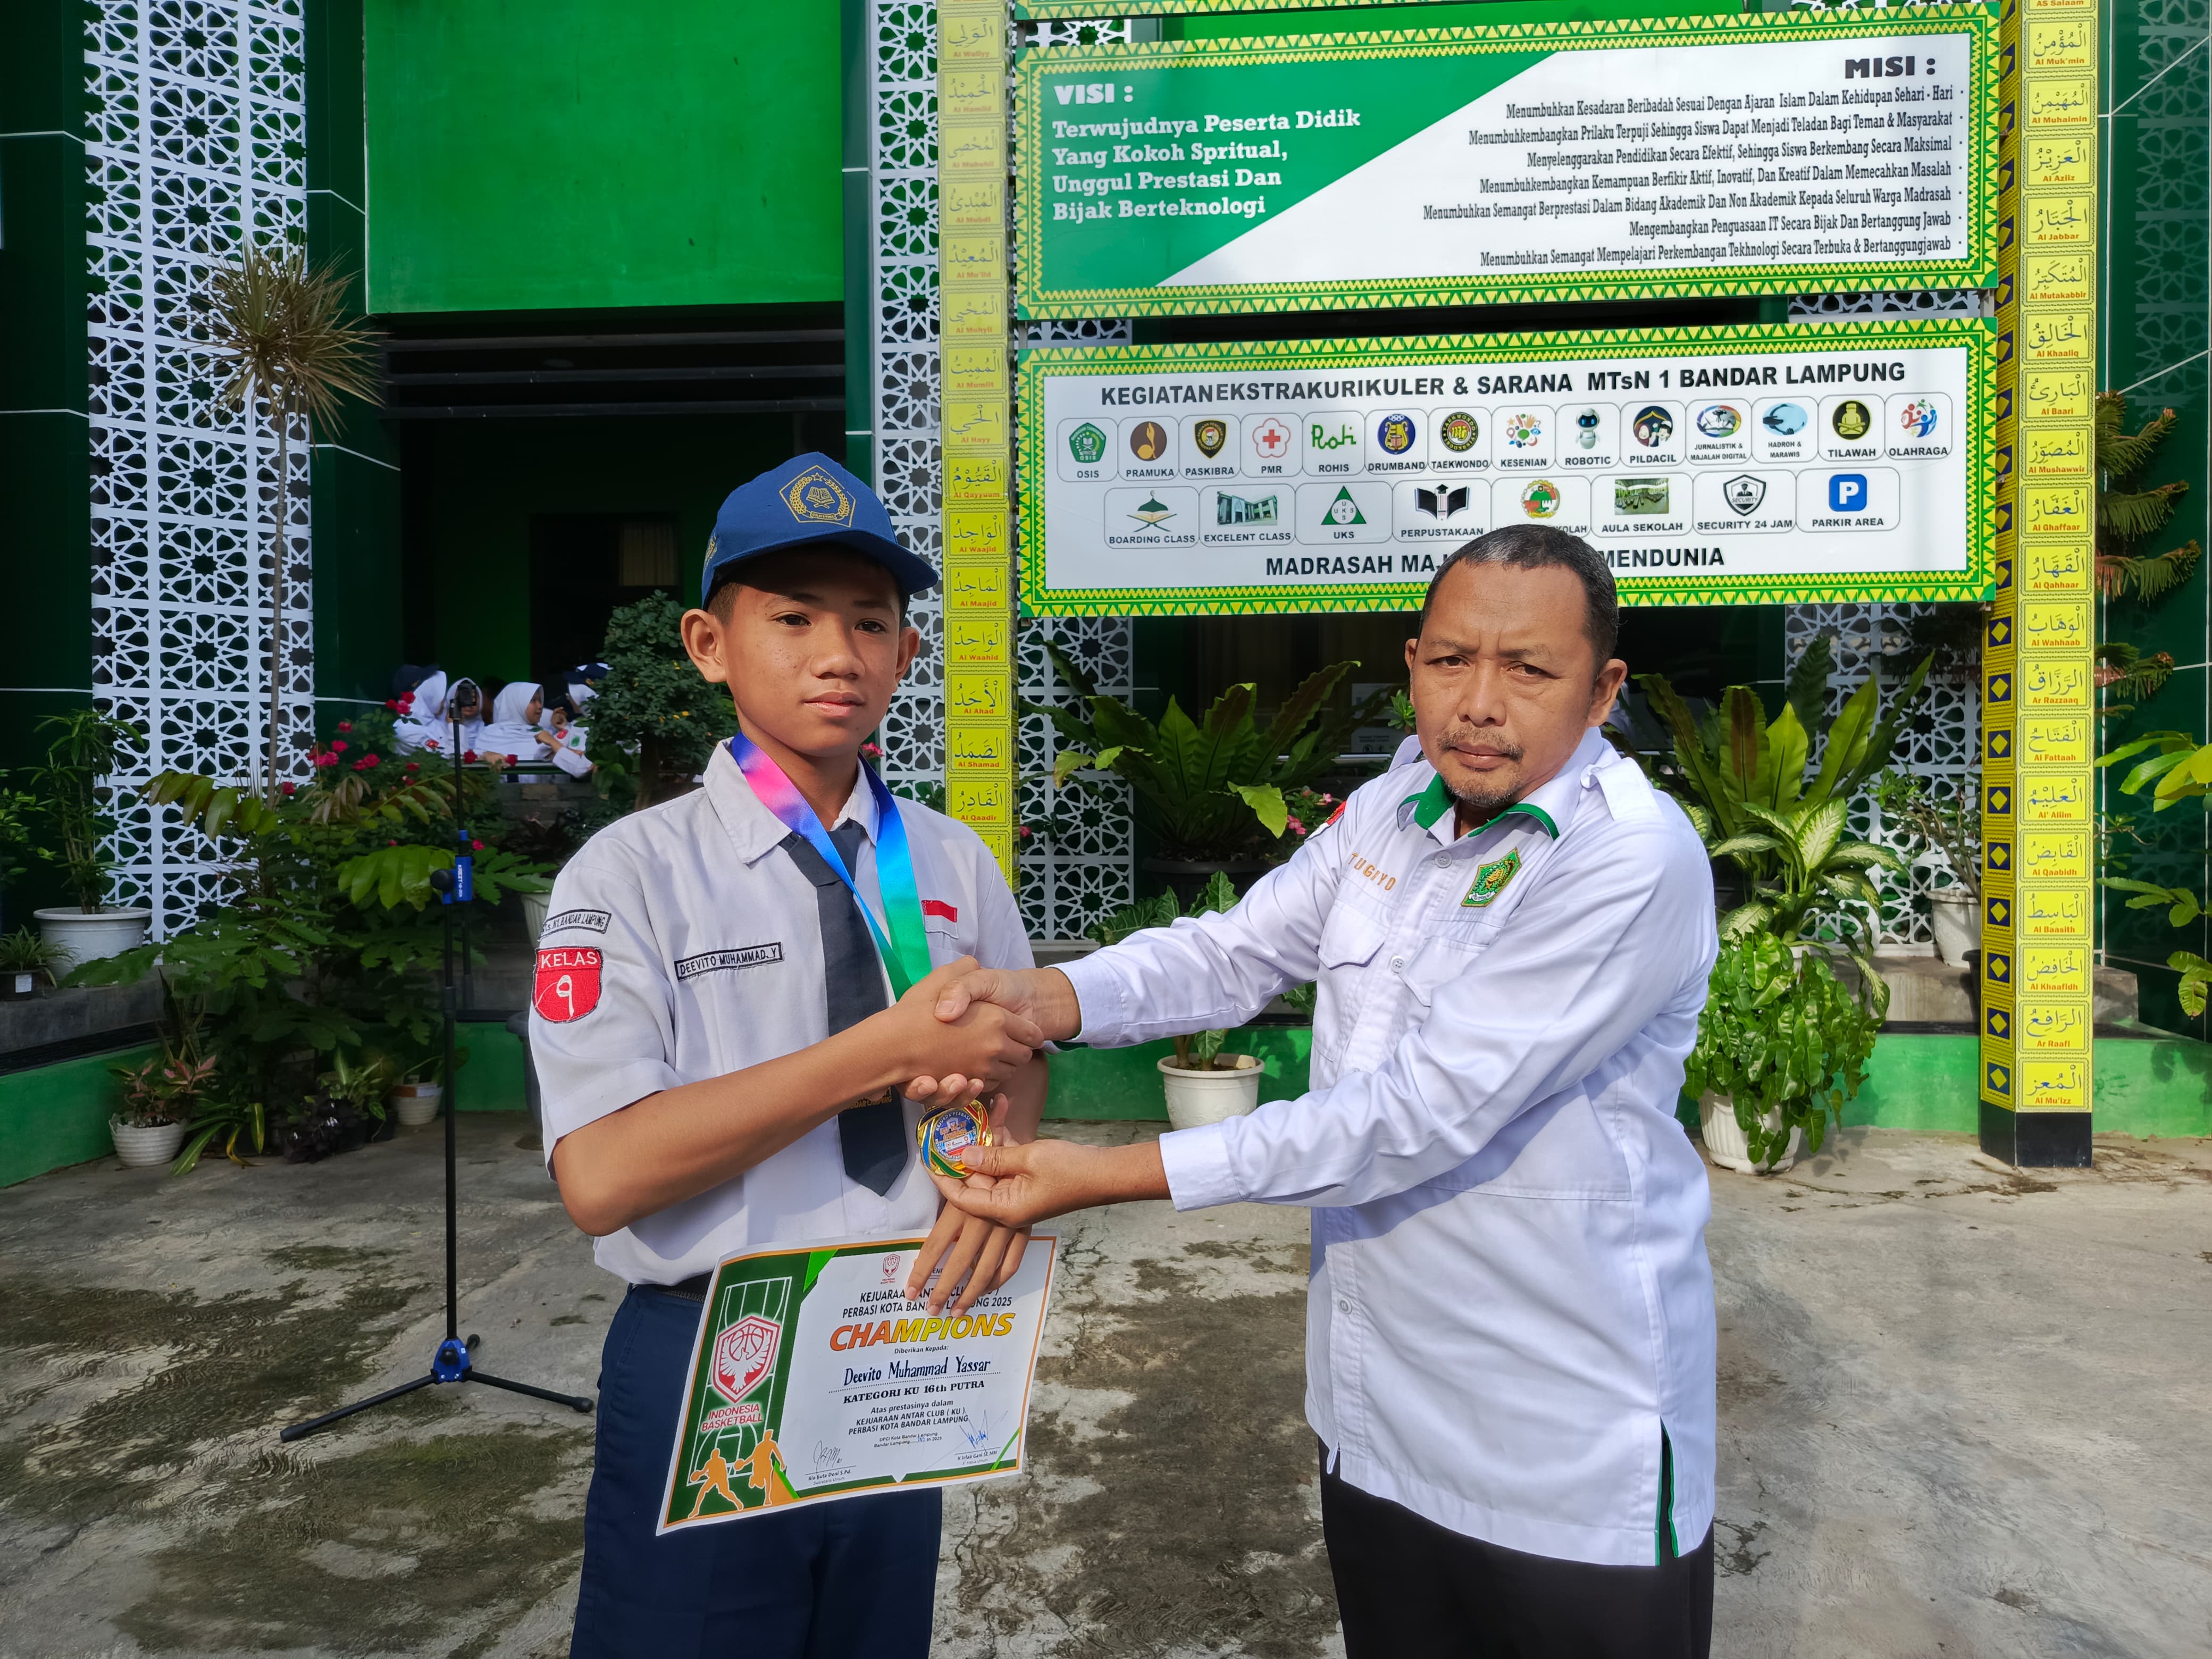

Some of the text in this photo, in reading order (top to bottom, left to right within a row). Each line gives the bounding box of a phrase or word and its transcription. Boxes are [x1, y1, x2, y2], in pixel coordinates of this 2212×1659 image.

[1052, 108, 1361, 140] Terwujudnya Peserta Didik
[1052, 139, 1287, 169] Yang Kokoh Spritual,
[1527, 135, 1952, 171] Menyelenggarakan Pendidikan Secara Efektif, Sehingga Siswa Berkembang Secara Maksimal
[1052, 168, 1282, 197] Unggul Prestasi Dan
[1480, 160, 1951, 195] Menumbuhkembangkan Kemampuan Berfikir Aktif, Inovatif, Dan Kreatif Dalam Memecahkan Masalah
[1053, 195, 1266, 224] Bijak Berteknologi
[1423, 185, 1951, 221] Menumbuhkan Semangat Berprestasi Dalam Bidang Akademik Dan Non Akademik Kepada Seluruh Warga Madrasah
[1453, 376, 1469, 395] &
[1477, 373, 1573, 395] SARANA
[1588, 370, 1649, 391] MTsN
[1659, 370, 1669, 389] 1
[1680, 366, 1778, 388] BANDAR
[1786, 362, 1905, 385] LAMPUNG
[1828, 448, 1876, 458] TILAWAH
[1889, 446, 1948, 456] OLAHRAGA
[1368, 462, 1425, 471] DRUMBAND
[1432, 459, 1488, 469] TAEKWONDO
[1501, 458, 1547, 467] KESENIAN
[1565, 455, 1611, 466] ROBOTIC
[1629, 454, 1677, 464] PILDACIL
[1126, 468, 1174, 477] PRAMUKA
[1186, 467, 1234, 476] PASKIBRA
[1319, 464, 1349, 473] ROHIS
[1839, 482, 1859, 505] P
[1602, 522, 1683, 533] AULA SEKOLAH
[1697, 519, 1792, 530] SECURITY 24 JAM
[1812, 517, 1884, 527] PARKIR AREA
[1109, 535, 1160, 544] BOARDING
[1204, 533, 1255, 542] EXCELENT
[1401, 527, 1483, 537] PERPUSTAKAAN
[1266, 555, 1392, 576] MADRASAH
[1348, 852, 1396, 891] TUGIYO
[541, 952, 598, 968] KELAS
[680, 956, 717, 975] DEEVITO
[860, 1289, 905, 1303] KEJUARAA
[991, 1297, 1012, 1307] 2025
[843, 1305, 877, 1318] PERBASI
[880, 1302, 902, 1313] KOTA
[830, 1313, 1016, 1351] CHAMPIONS
[844, 1356, 990, 1386] Deevito Muhammad Yassar
[843, 1390, 900, 1404] KATEGORI
[904, 1387, 919, 1396] KU
[950, 1380, 984, 1391] PUTRA
[708, 1404, 759, 1420] INDONESIA
[889, 1401, 929, 1413] prestasinya
[702, 1413, 763, 1431] BASKETBALL
[849, 1415, 968, 1435] PERBASI KOTA BANDAR LAMPUNG
[857, 1414, 899, 1426] KEJUARAAN
[901, 1411, 925, 1420] ANTAR
